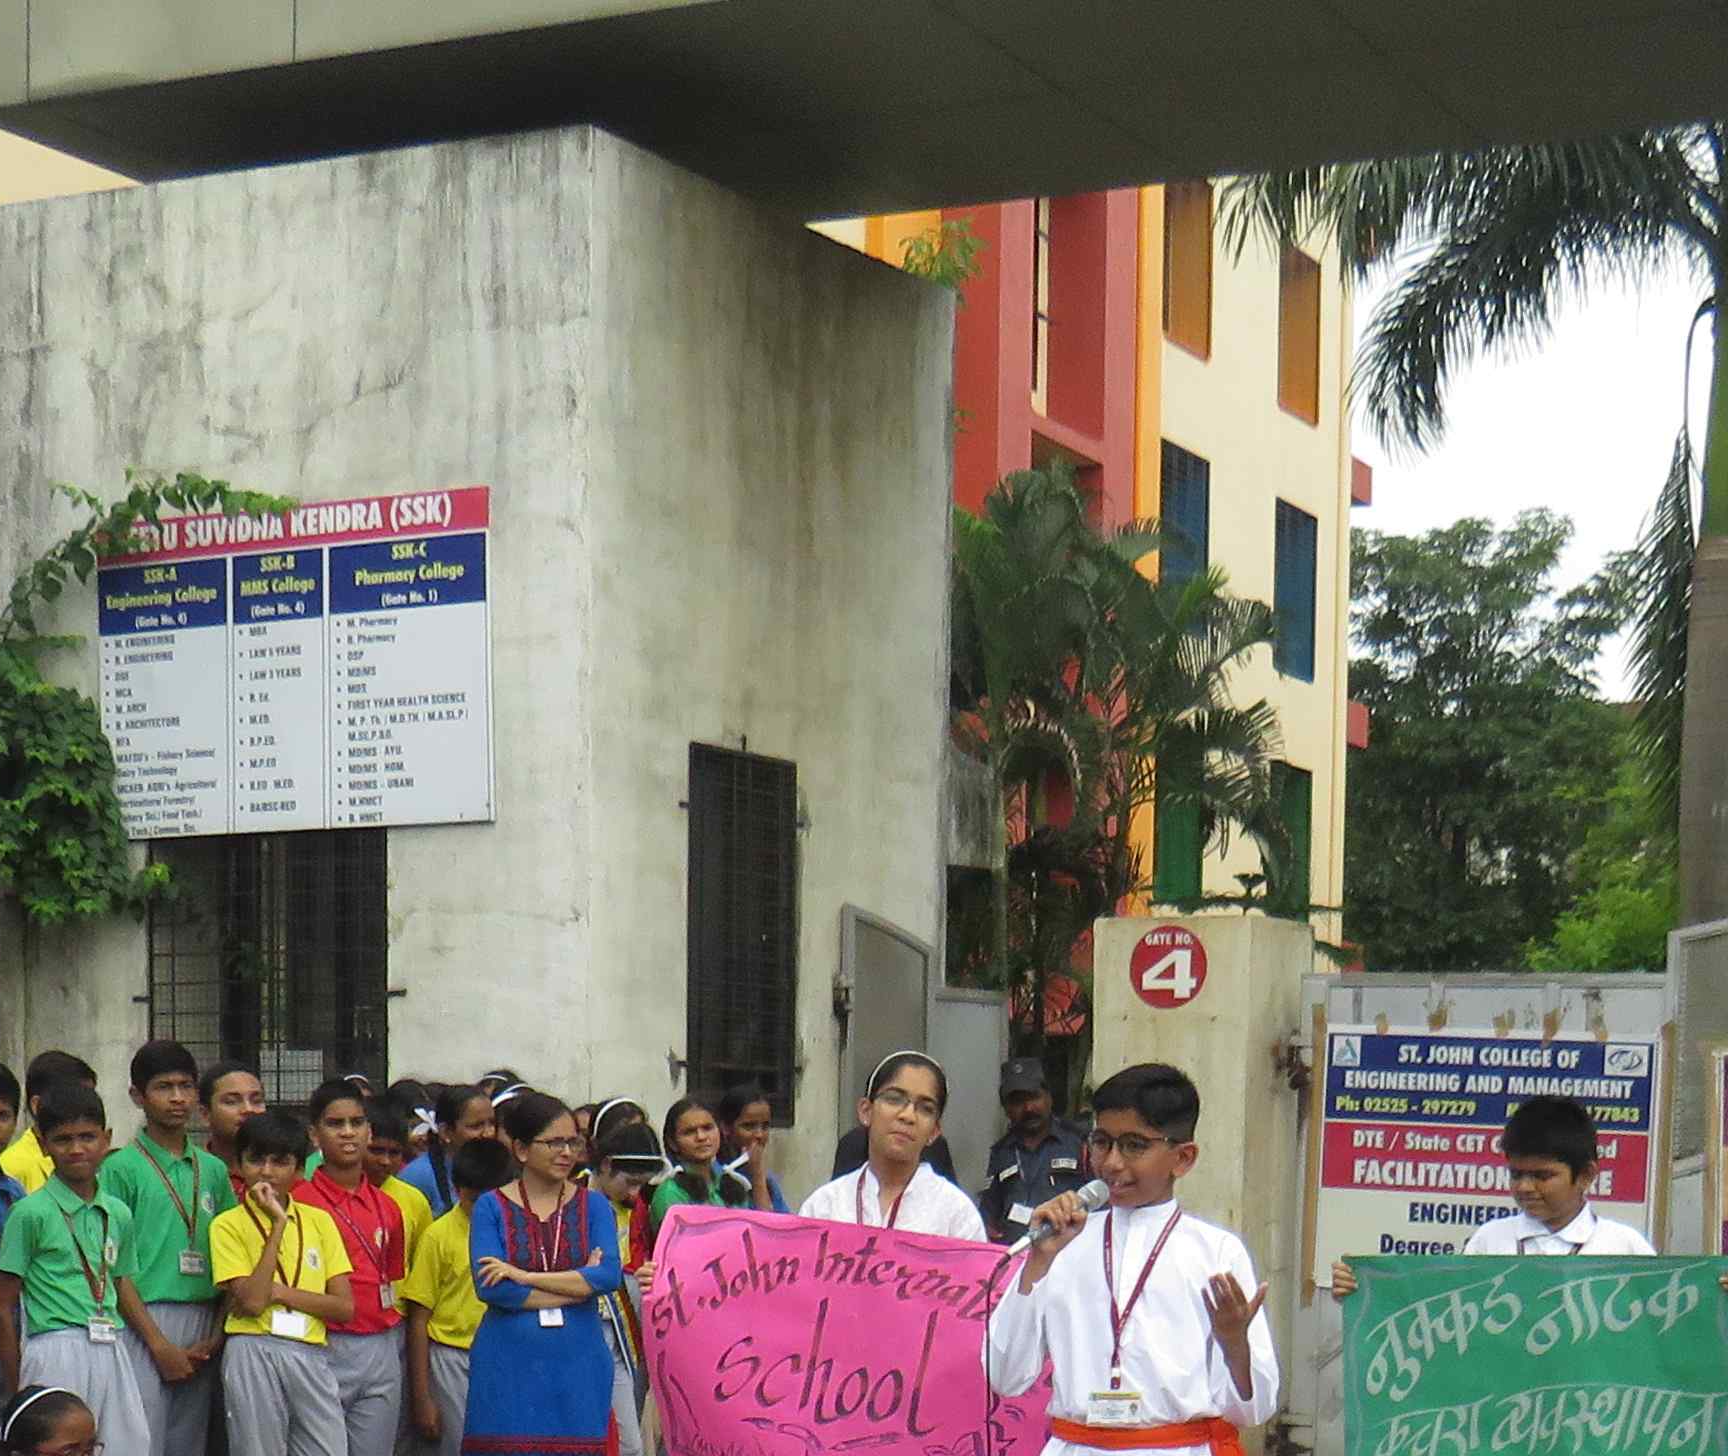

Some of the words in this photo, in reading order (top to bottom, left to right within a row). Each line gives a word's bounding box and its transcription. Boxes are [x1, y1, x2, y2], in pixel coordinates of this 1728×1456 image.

[290, 500, 383, 537] KENDRA
[390, 492, 452, 532] (SSK)
[391, 542, 427, 560] SSK-C
[239, 579, 269, 597] MMS
[272, 576, 315, 595] College
[355, 567, 416, 587] Pharmacy
[419, 561, 465, 581] College
[106, 590, 172, 611] Engineering
[175, 586, 217, 604] College
[1145, 933, 1172, 946] GATE
[1141, 949, 1197, 1000] 4
[1398, 1044, 1422, 1064] ST.
[1427, 1046, 1474, 1066] JOHN
[1479, 1047, 1551, 1068] COLLEGE
[1557, 1050, 1581, 1070] OF
[1344, 1070, 1460, 1094] ENGINEERING
[1465, 1074, 1503, 1095] AND
[1507, 1076, 1634, 1099] MANAGEMENT
[1335, 1095, 1360, 1112] Ph:
[1363, 1096, 1409, 1114] 02525
[1353, 1130, 1384, 1149] DTE
[1404, 1131, 1450, 1152] State
[1455, 1133, 1486, 1153] CET
[1353, 1160, 1511, 1191] FACILITATION
[1379, 1234, 1462, 1256] Degree
[703, 1227, 801, 1312] John
[1524, 1261, 1709, 1356] नाटक
[712, 1296, 937, 1439] School
